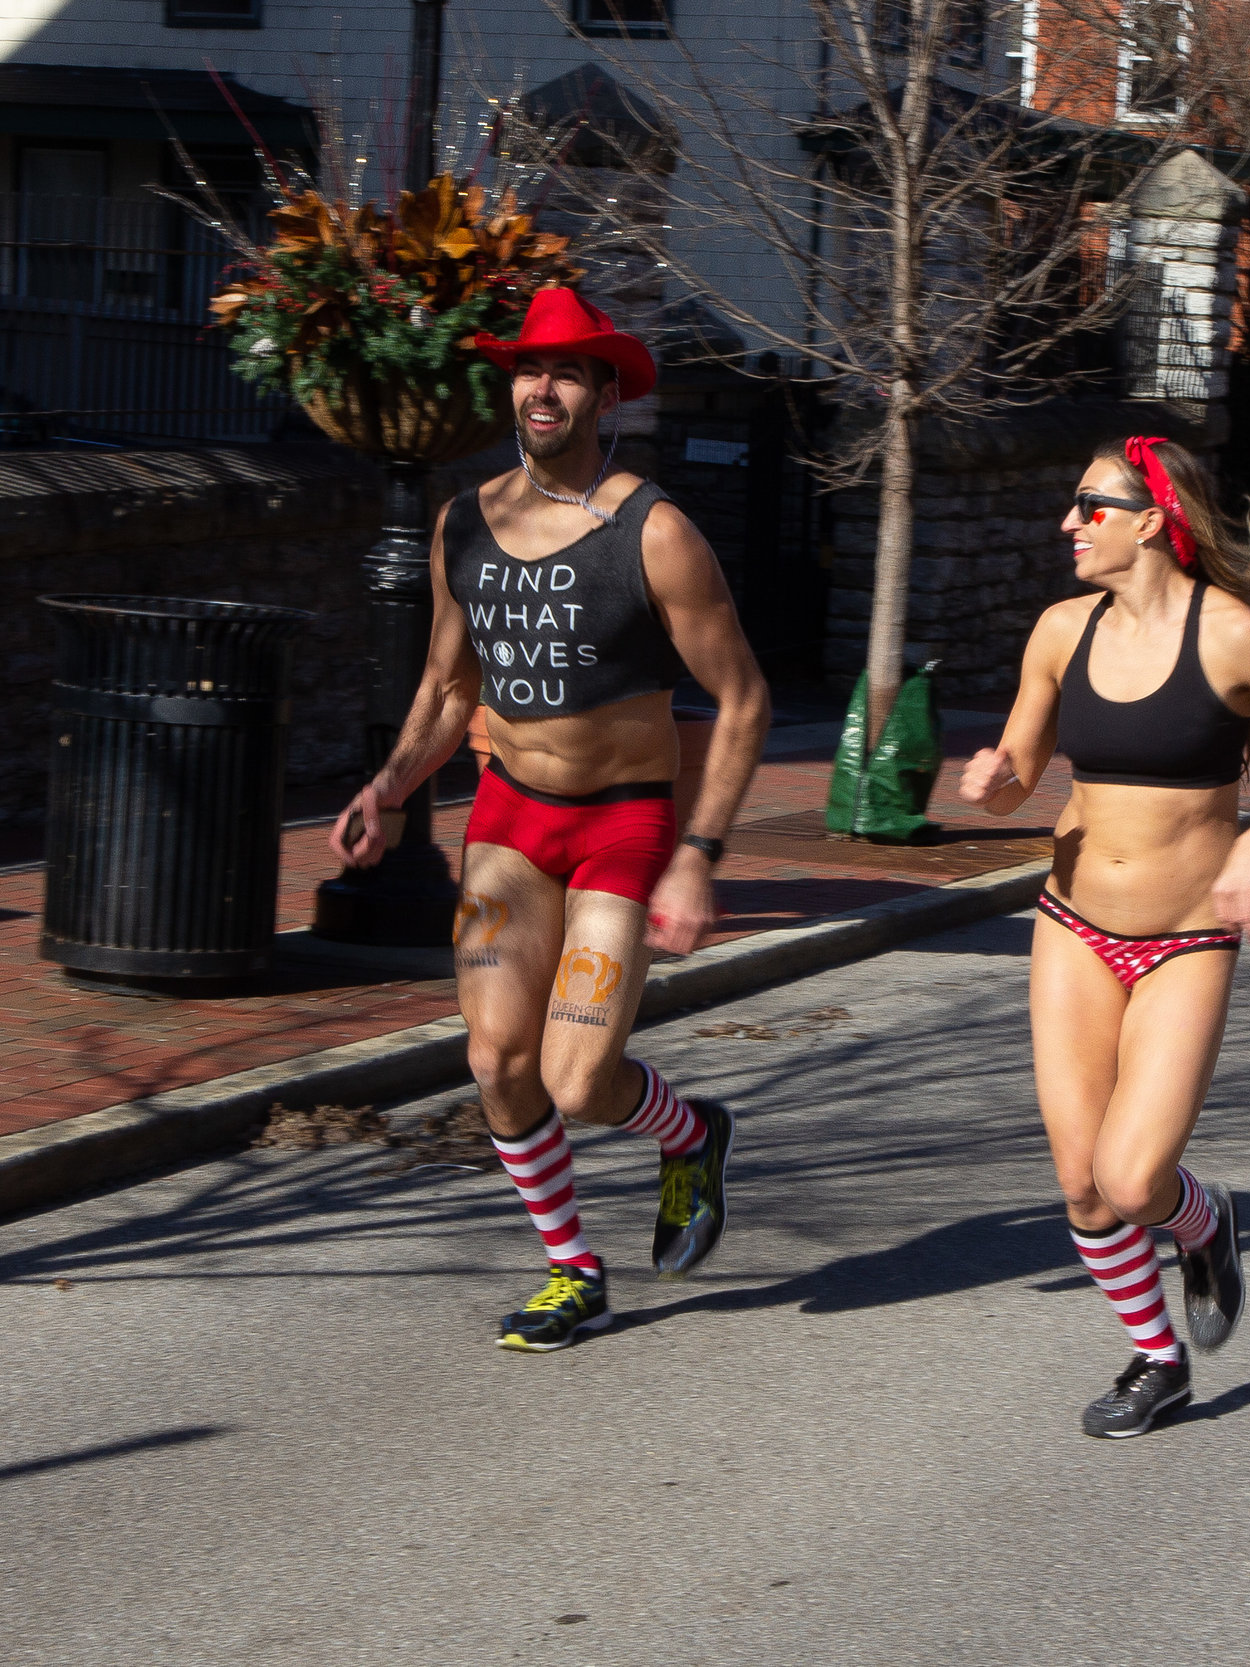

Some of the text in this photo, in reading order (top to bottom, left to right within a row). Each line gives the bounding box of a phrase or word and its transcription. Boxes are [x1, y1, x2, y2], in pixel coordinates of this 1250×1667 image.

[478, 562, 576, 593] FIND
[468, 601, 584, 632] WHAT
[491, 674, 565, 706] YOU
[550, 1010, 608, 1026] KETTLEBELL
[552, 1000, 610, 1017] QUEEN CITY
